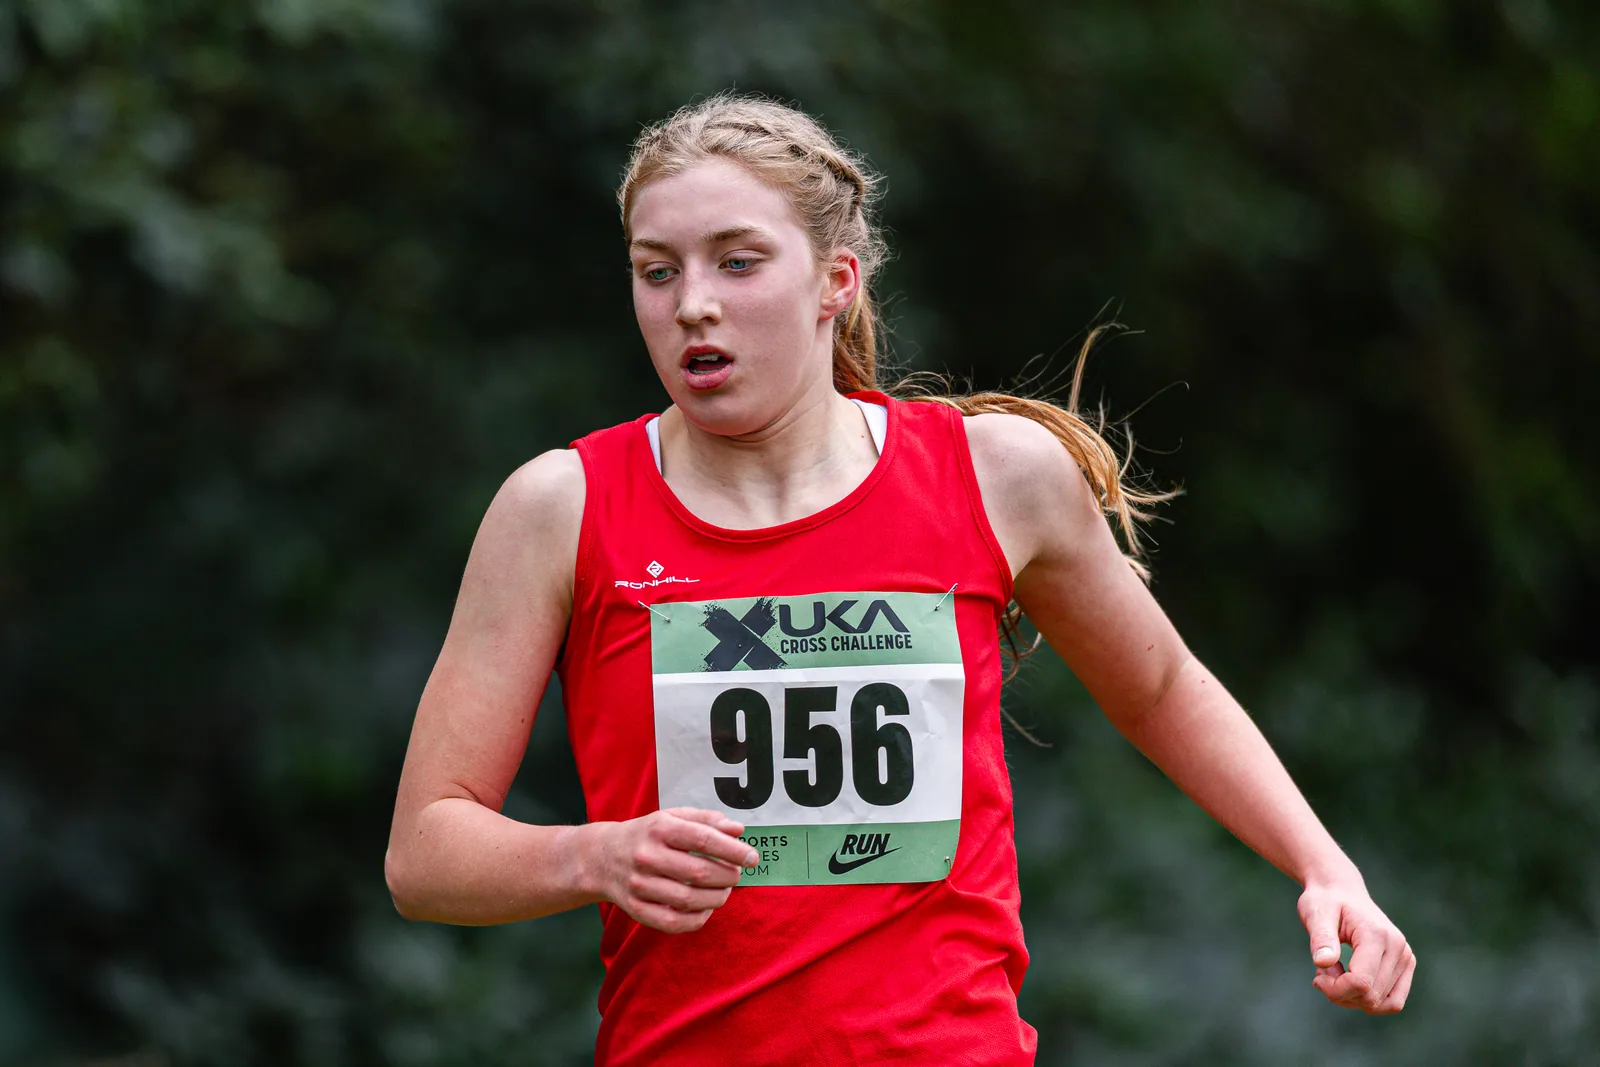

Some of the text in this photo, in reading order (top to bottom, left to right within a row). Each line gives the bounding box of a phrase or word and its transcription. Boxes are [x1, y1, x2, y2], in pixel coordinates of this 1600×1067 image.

[615, 576, 700, 589] RONHILL
[779, 600, 910, 637] UKA
[781, 634, 913, 654] CROSS CHALLENGE
[710, 682, 914, 810] 956
[840, 833, 891, 855] RUN
